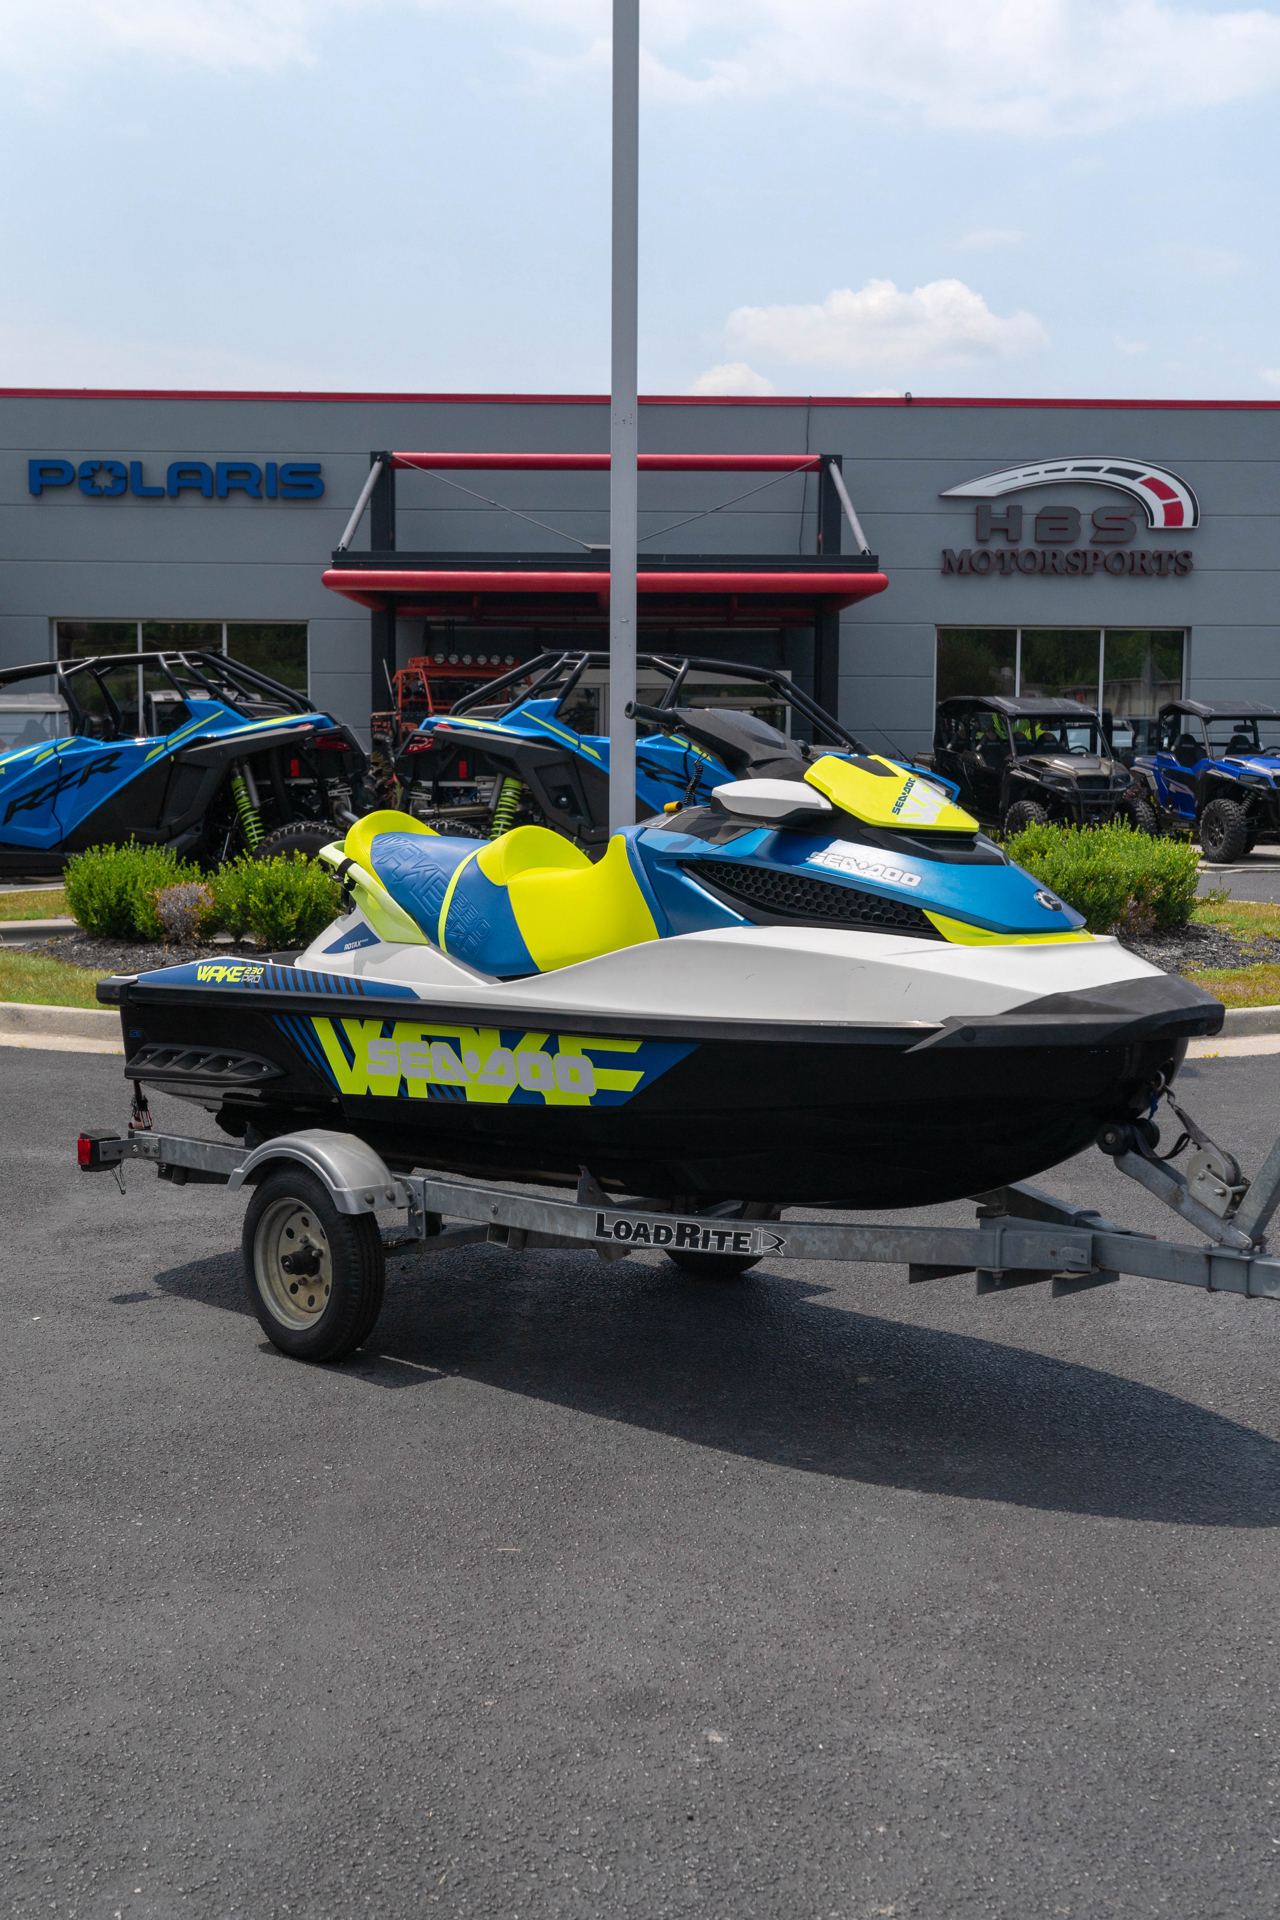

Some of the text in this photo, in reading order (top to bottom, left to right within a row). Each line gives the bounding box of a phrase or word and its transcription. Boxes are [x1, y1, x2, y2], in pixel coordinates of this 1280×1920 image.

[28, 459, 325, 499] POLARIS
[975, 504, 1137, 543] HBS
[941, 549, 1194, 576] MOTORSPORTS
[2, 751, 123, 827] RZR
[344, 940, 361, 951] ROTAX
[197, 965, 265, 983] WAKE 230
[241, 974, 261, 983] PRO
